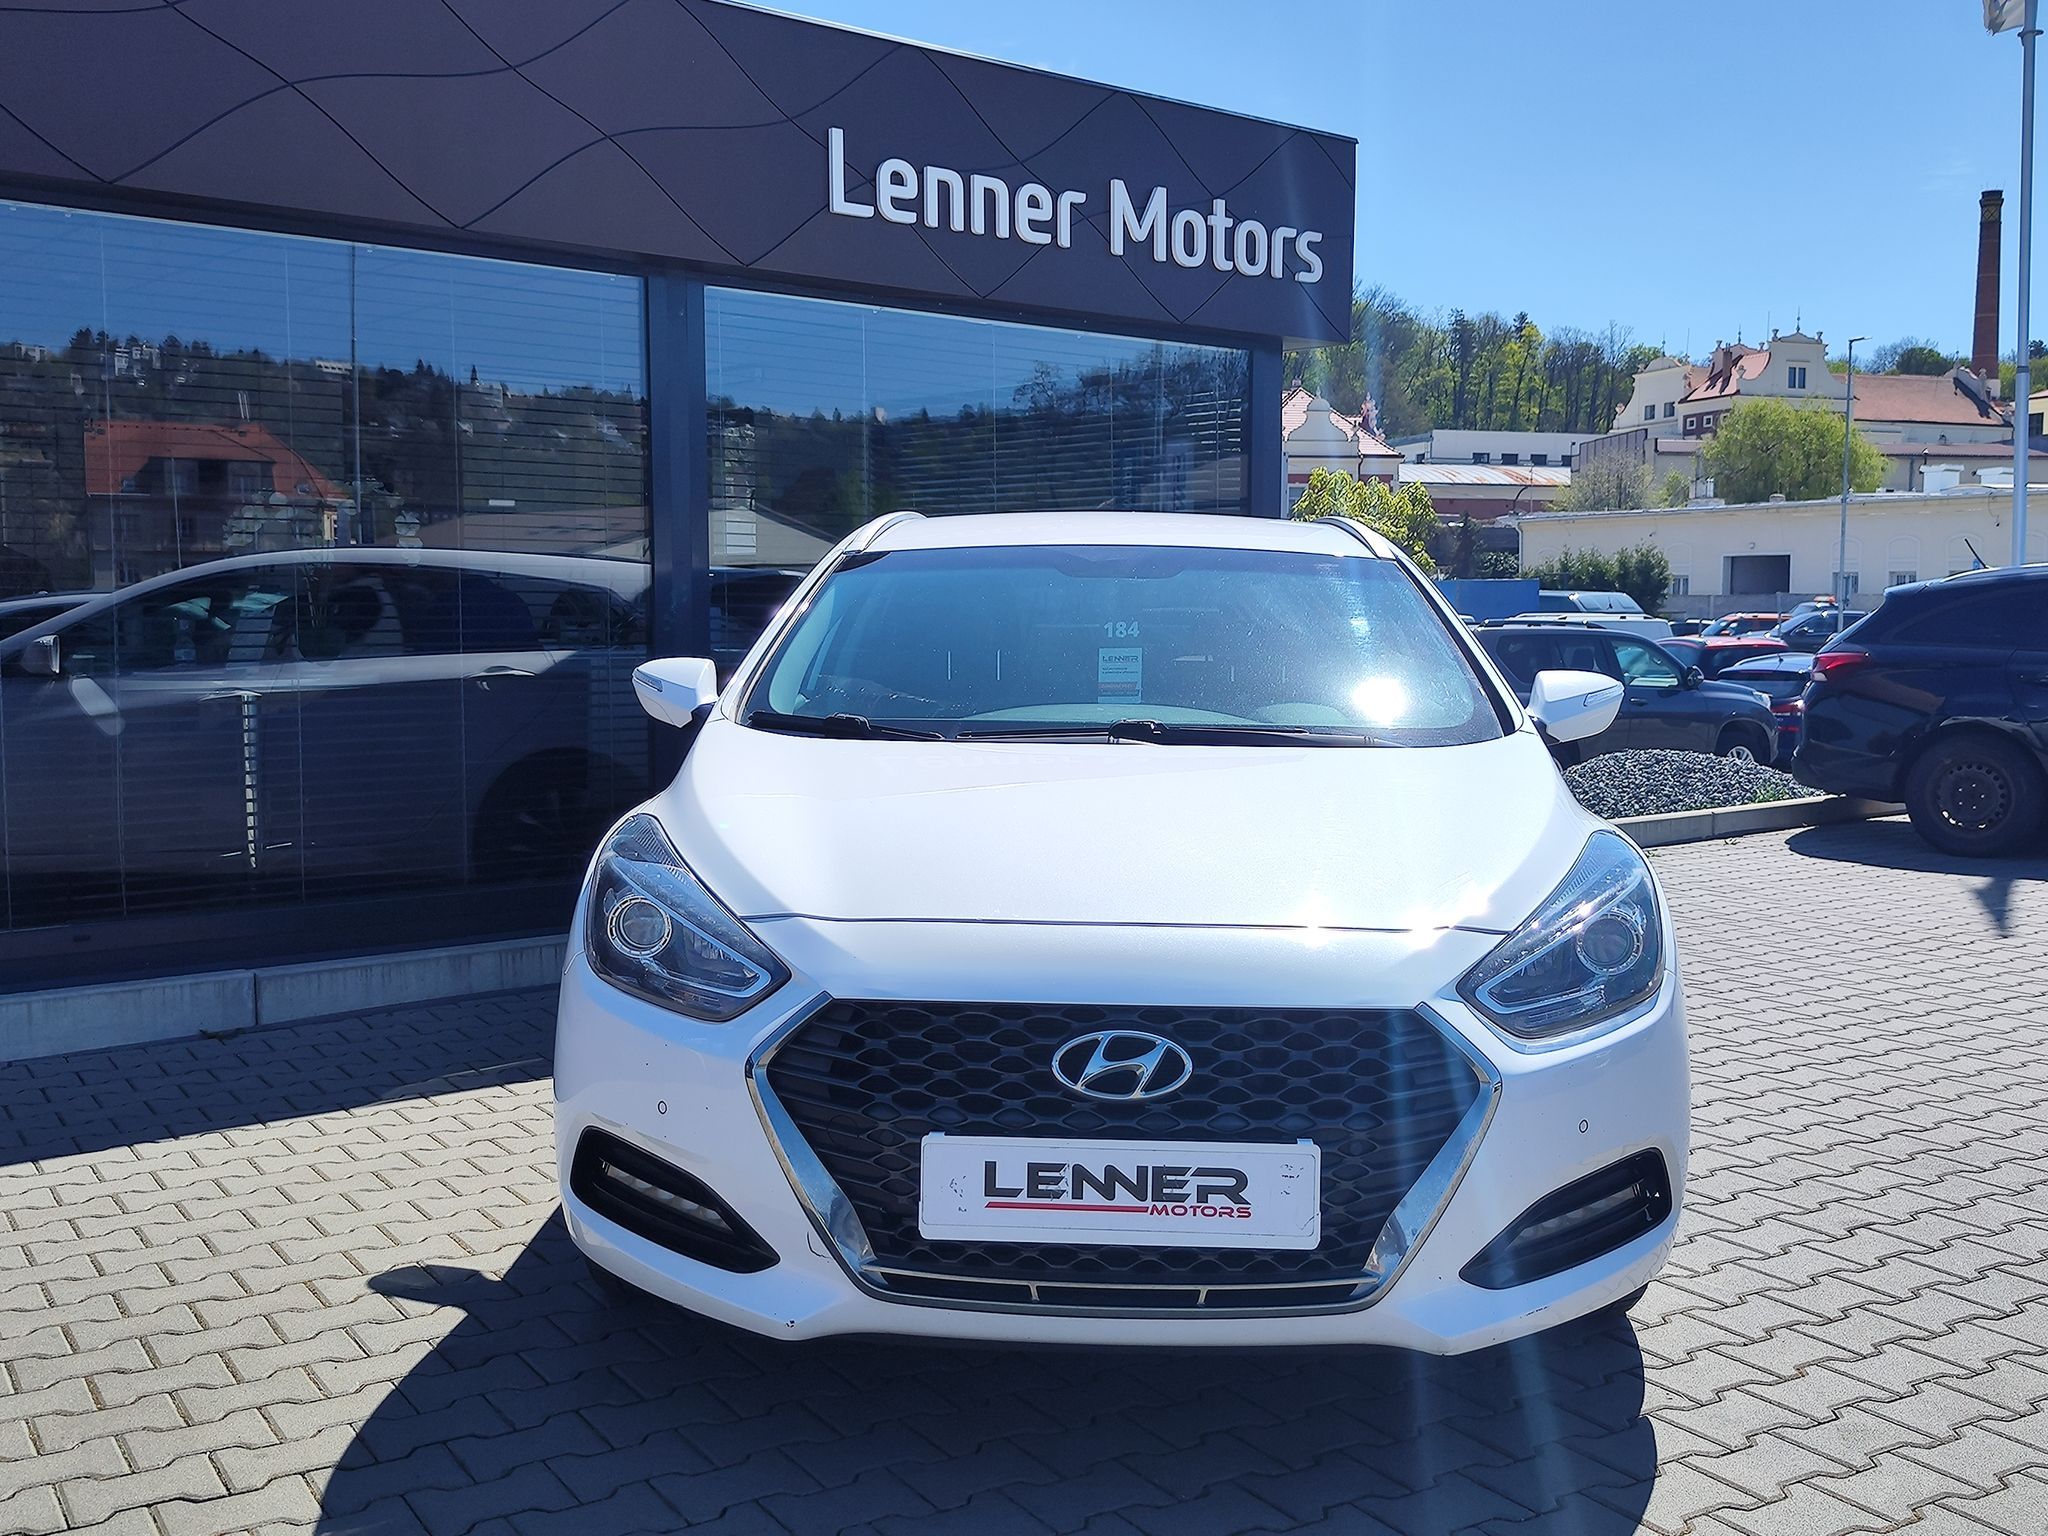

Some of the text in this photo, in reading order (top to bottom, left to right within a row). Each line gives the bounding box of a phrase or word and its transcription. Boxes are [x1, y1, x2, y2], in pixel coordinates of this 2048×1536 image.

[828, 127, 1323, 283] Lenner Motors
[1103, 621, 1140, 638] 184
[984, 1160, 1251, 1205] LENNER
[1149, 1204, 1253, 1219] MOTORS
